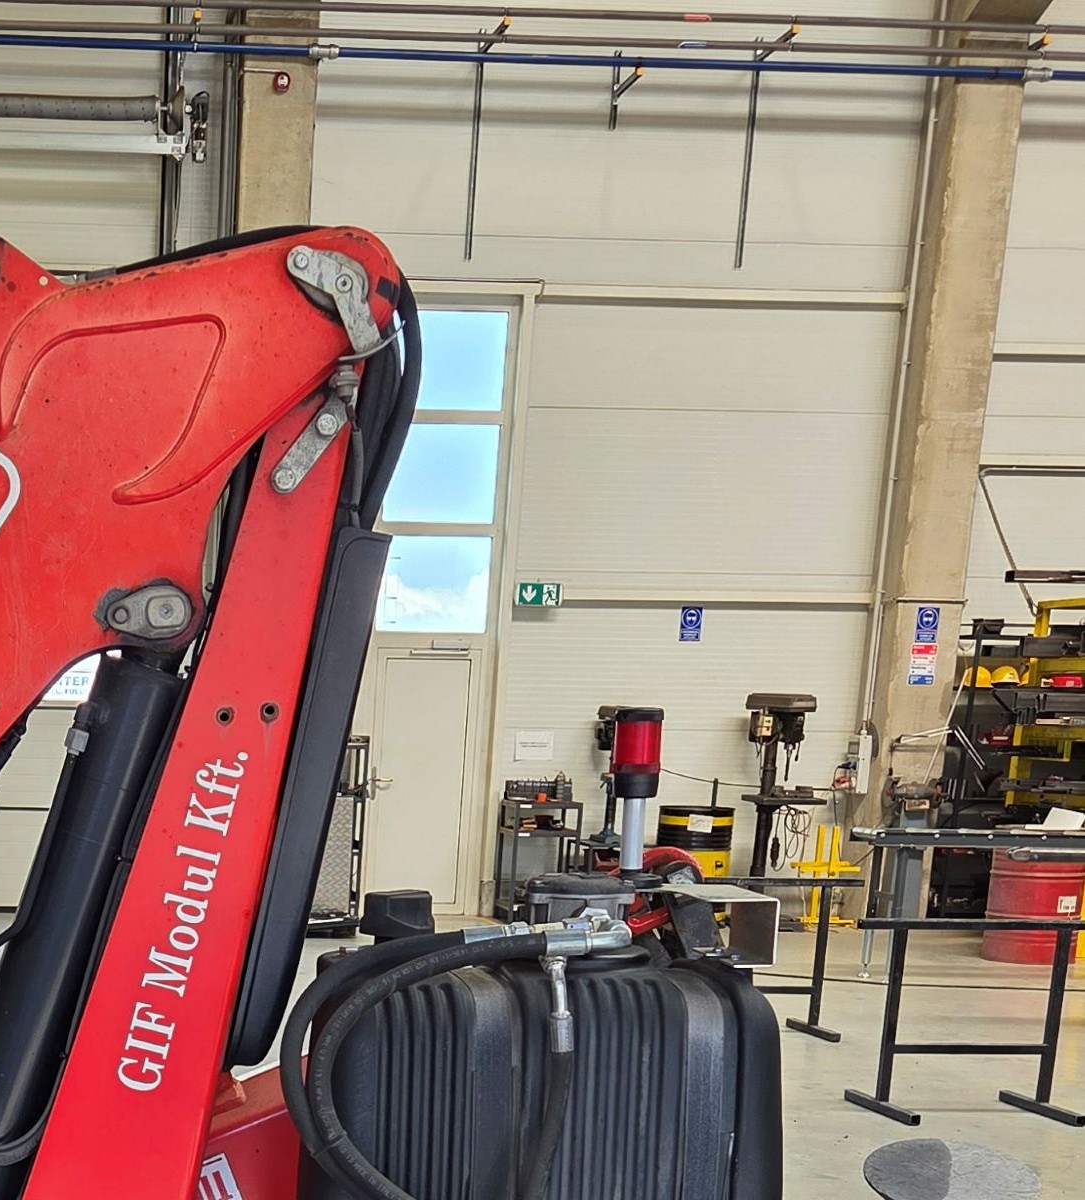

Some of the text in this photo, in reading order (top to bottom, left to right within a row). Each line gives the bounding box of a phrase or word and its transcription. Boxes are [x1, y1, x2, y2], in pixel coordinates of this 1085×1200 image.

[116, 750, 250, 1092] GIF Modul Kft.
